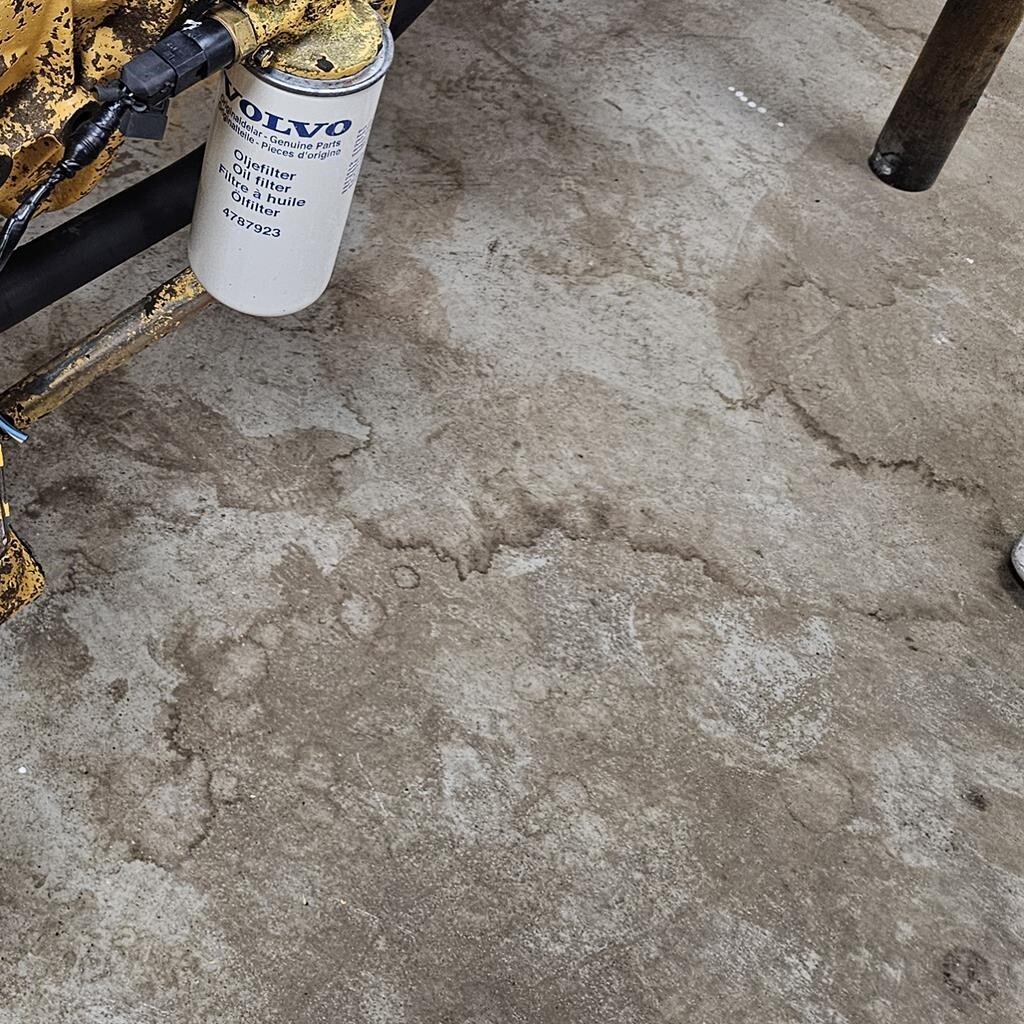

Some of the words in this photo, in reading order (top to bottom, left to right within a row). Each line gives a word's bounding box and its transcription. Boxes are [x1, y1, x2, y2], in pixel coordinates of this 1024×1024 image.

[224, 70, 353, 138] VOLVO
[269, 135, 313, 151] Genuine
[316, 139, 342, 151] Parts
[297, 148, 342, 161] d'origine
[232, 163, 251, 181] Oil
[255, 176, 292, 194] filter
[234, 149, 297, 181] Oljefilter
[218, 163, 249, 193] Filtre
[253, 188, 262, 200] à
[267, 193, 306, 207] huile
[231, 189, 281, 217] Ölfilter
[222, 208, 281, 238] 4787923
